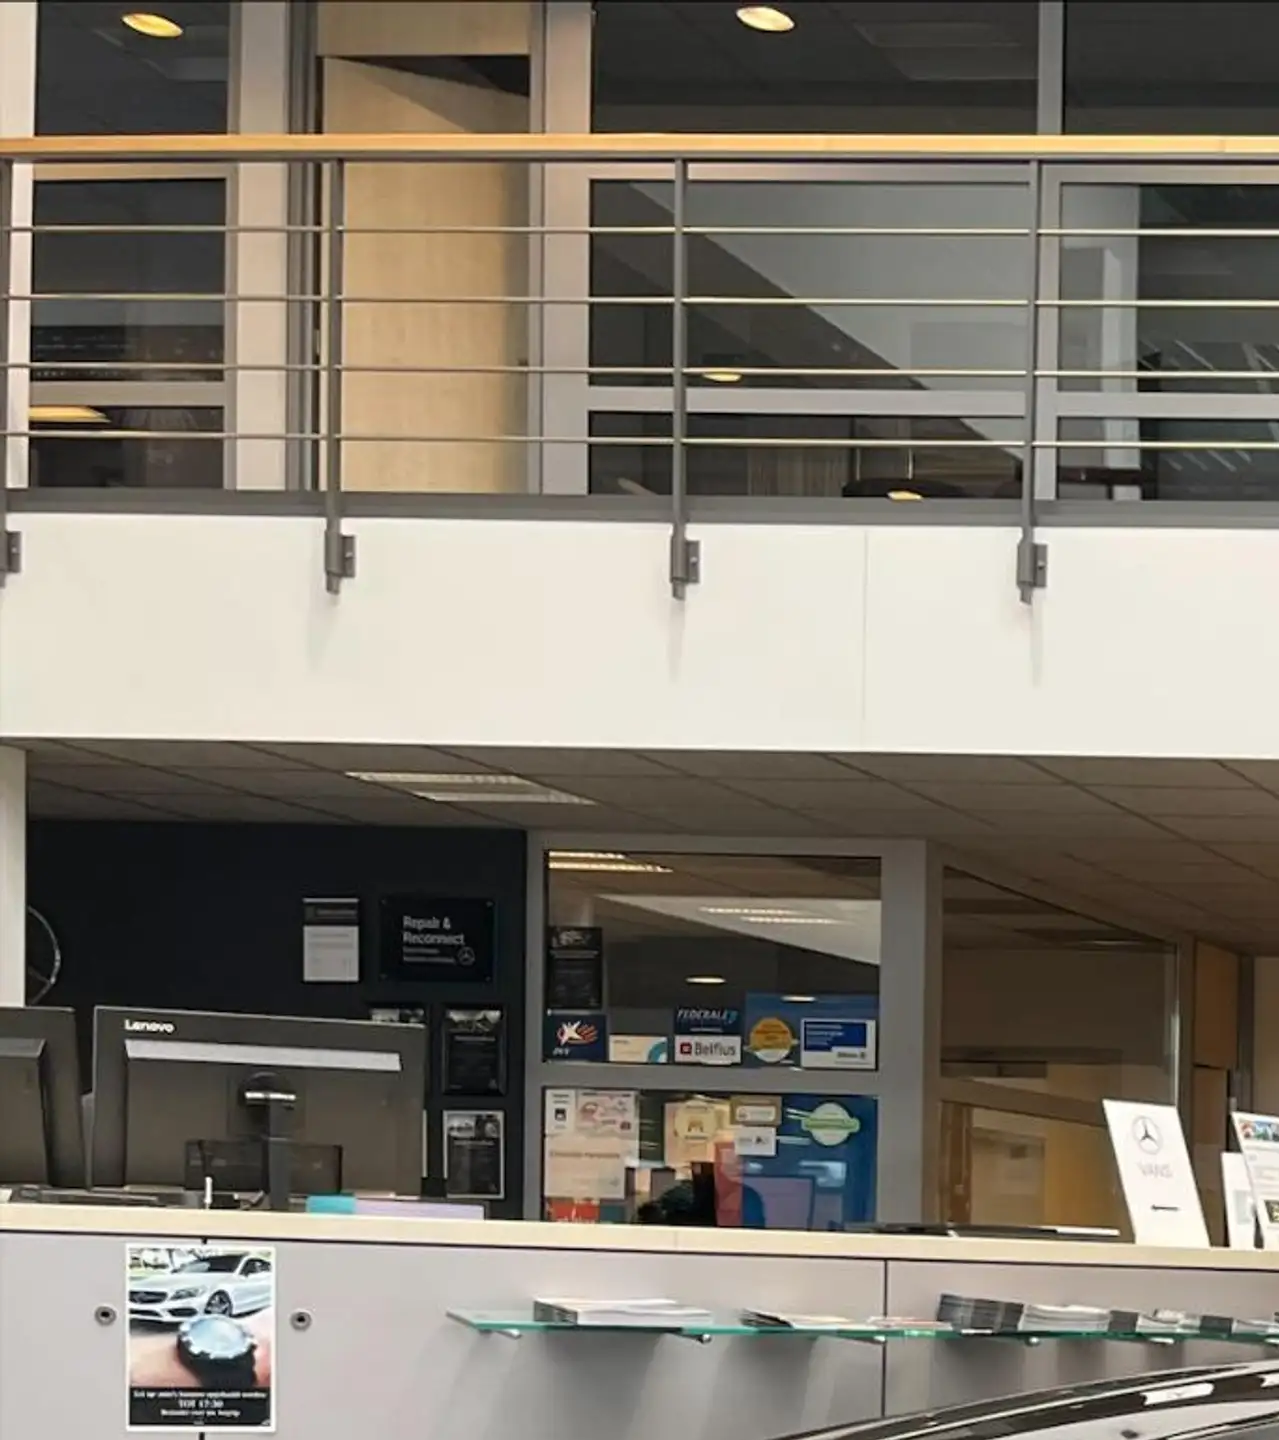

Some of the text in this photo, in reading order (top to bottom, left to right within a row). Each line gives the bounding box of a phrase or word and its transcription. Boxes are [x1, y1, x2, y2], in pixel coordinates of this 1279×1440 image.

[402, 915, 451, 930] Repair &
[402, 931, 465, 945] Reconnect
[124, 1019, 175, 1033] Lenovo
[694, 1041, 736, 1057] Belfius
